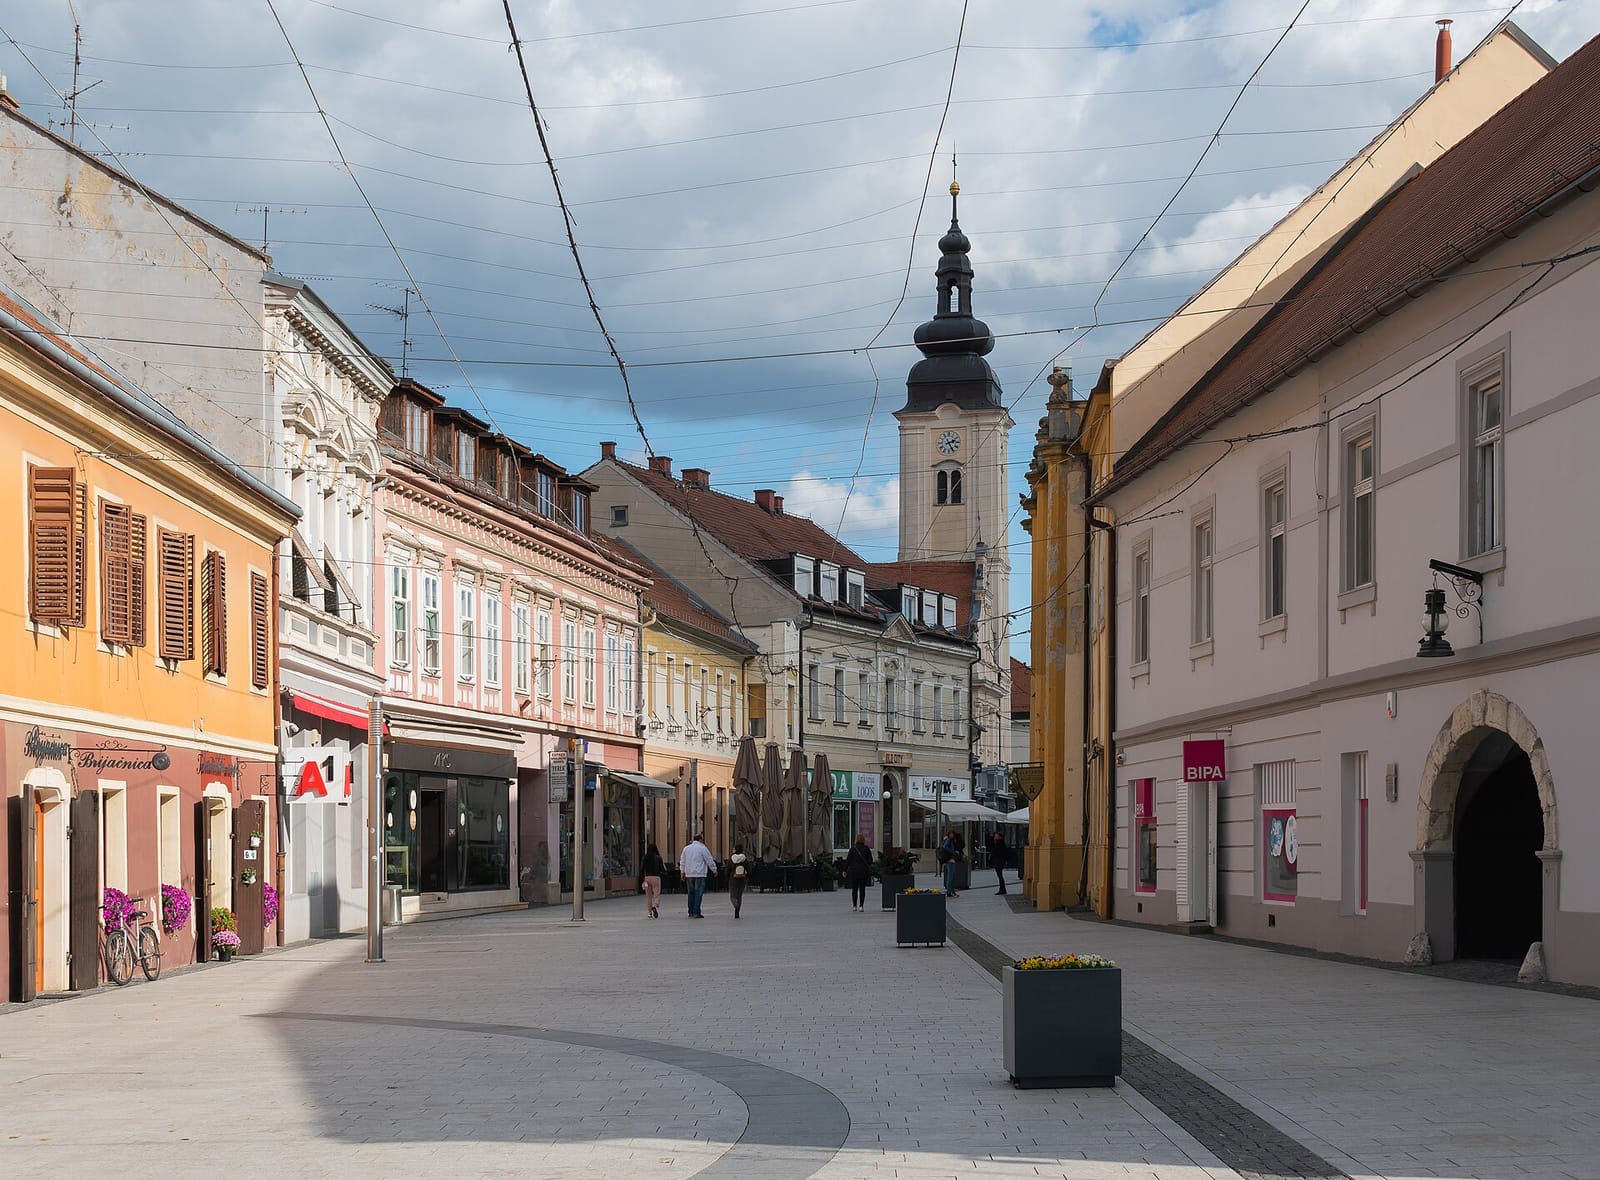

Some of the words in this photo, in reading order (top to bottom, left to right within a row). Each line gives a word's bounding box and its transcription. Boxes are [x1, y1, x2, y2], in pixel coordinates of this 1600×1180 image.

[295, 755, 334, 797] A1
[1187, 766, 1223, 780] BIPA
[857, 786, 875, 799] LOGOS
[1136, 803, 1144, 815] BIPA
